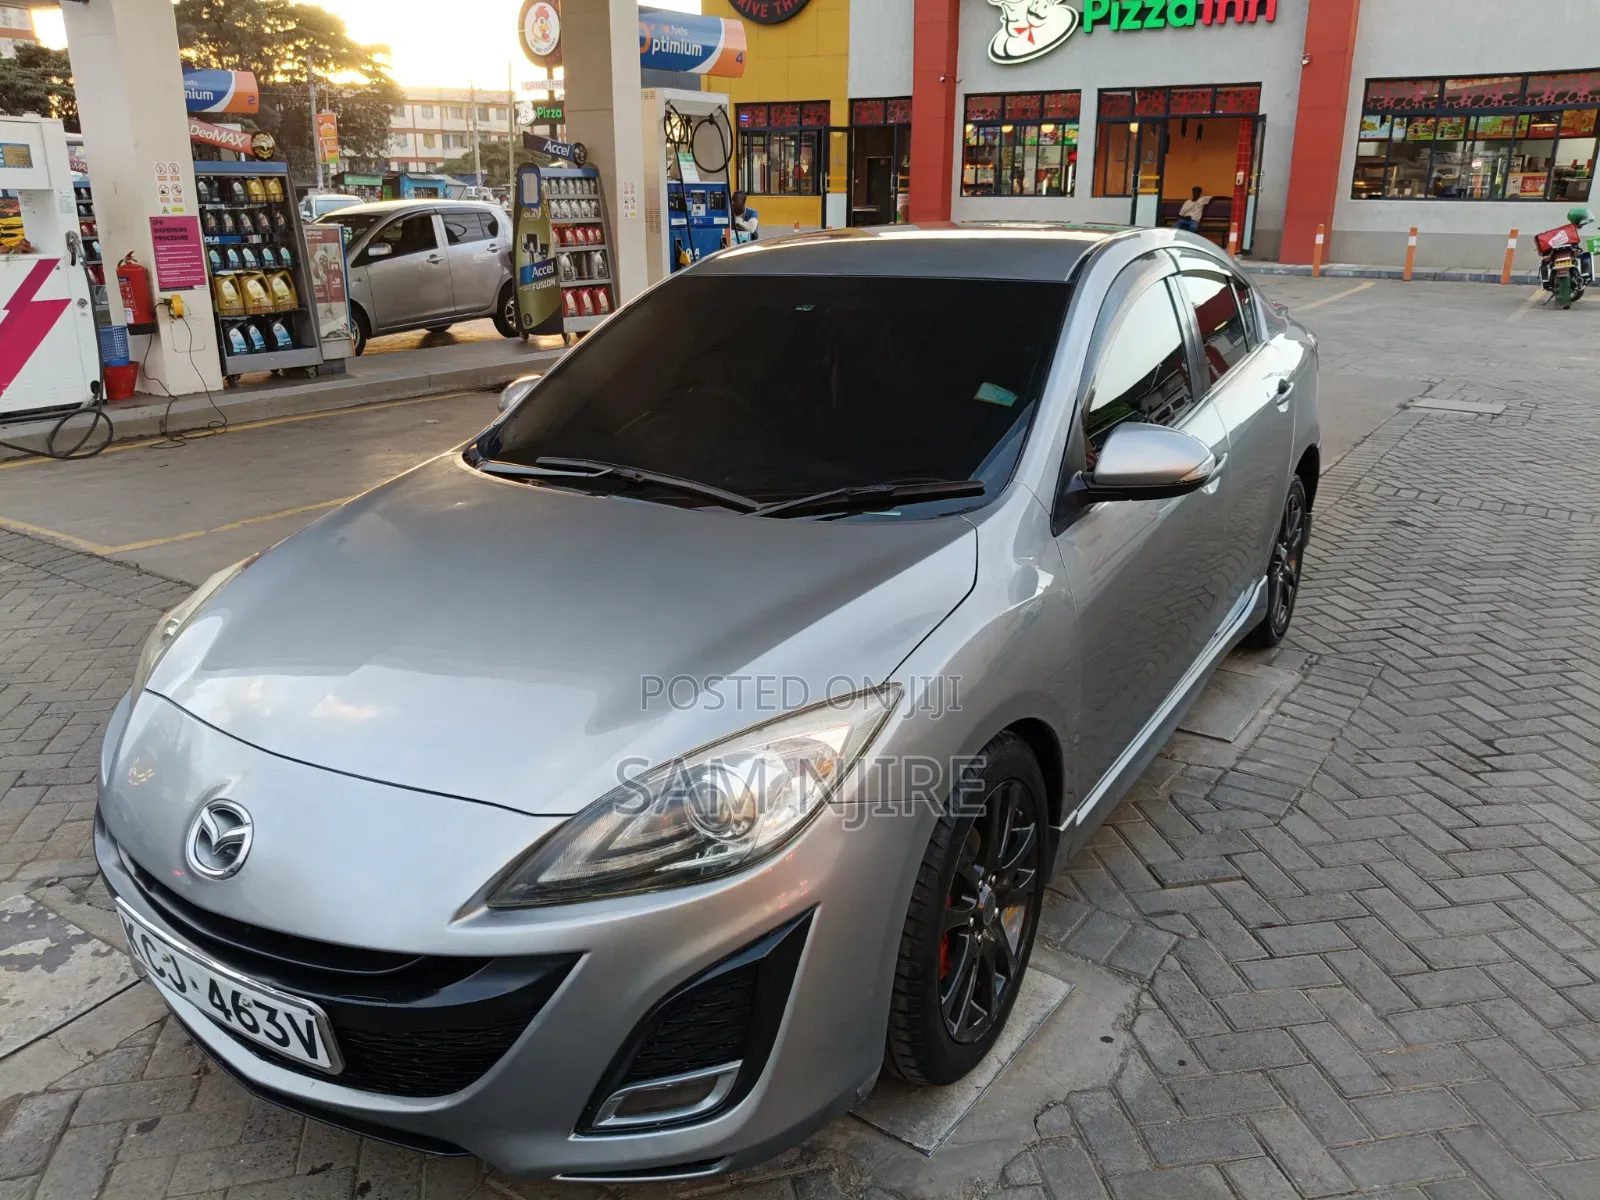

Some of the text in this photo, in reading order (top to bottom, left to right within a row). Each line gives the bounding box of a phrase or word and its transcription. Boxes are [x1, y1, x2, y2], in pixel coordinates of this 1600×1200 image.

[1082, 0, 1196, 33] Pizza
[735, 51, 744, 65] 4
[525, 81, 547, 91] DRIVE
[247, 95, 256, 106] 2
[536, 106, 563, 119] Pizza
[189, 124, 247, 148] DeoMAX
[543, 140, 571, 157] Accel
[204, 235, 220, 243] OLA
[531, 262, 554, 279] Accel
[531, 278, 556, 291] FUSION
[207, 977, 319, 1061] 463V
